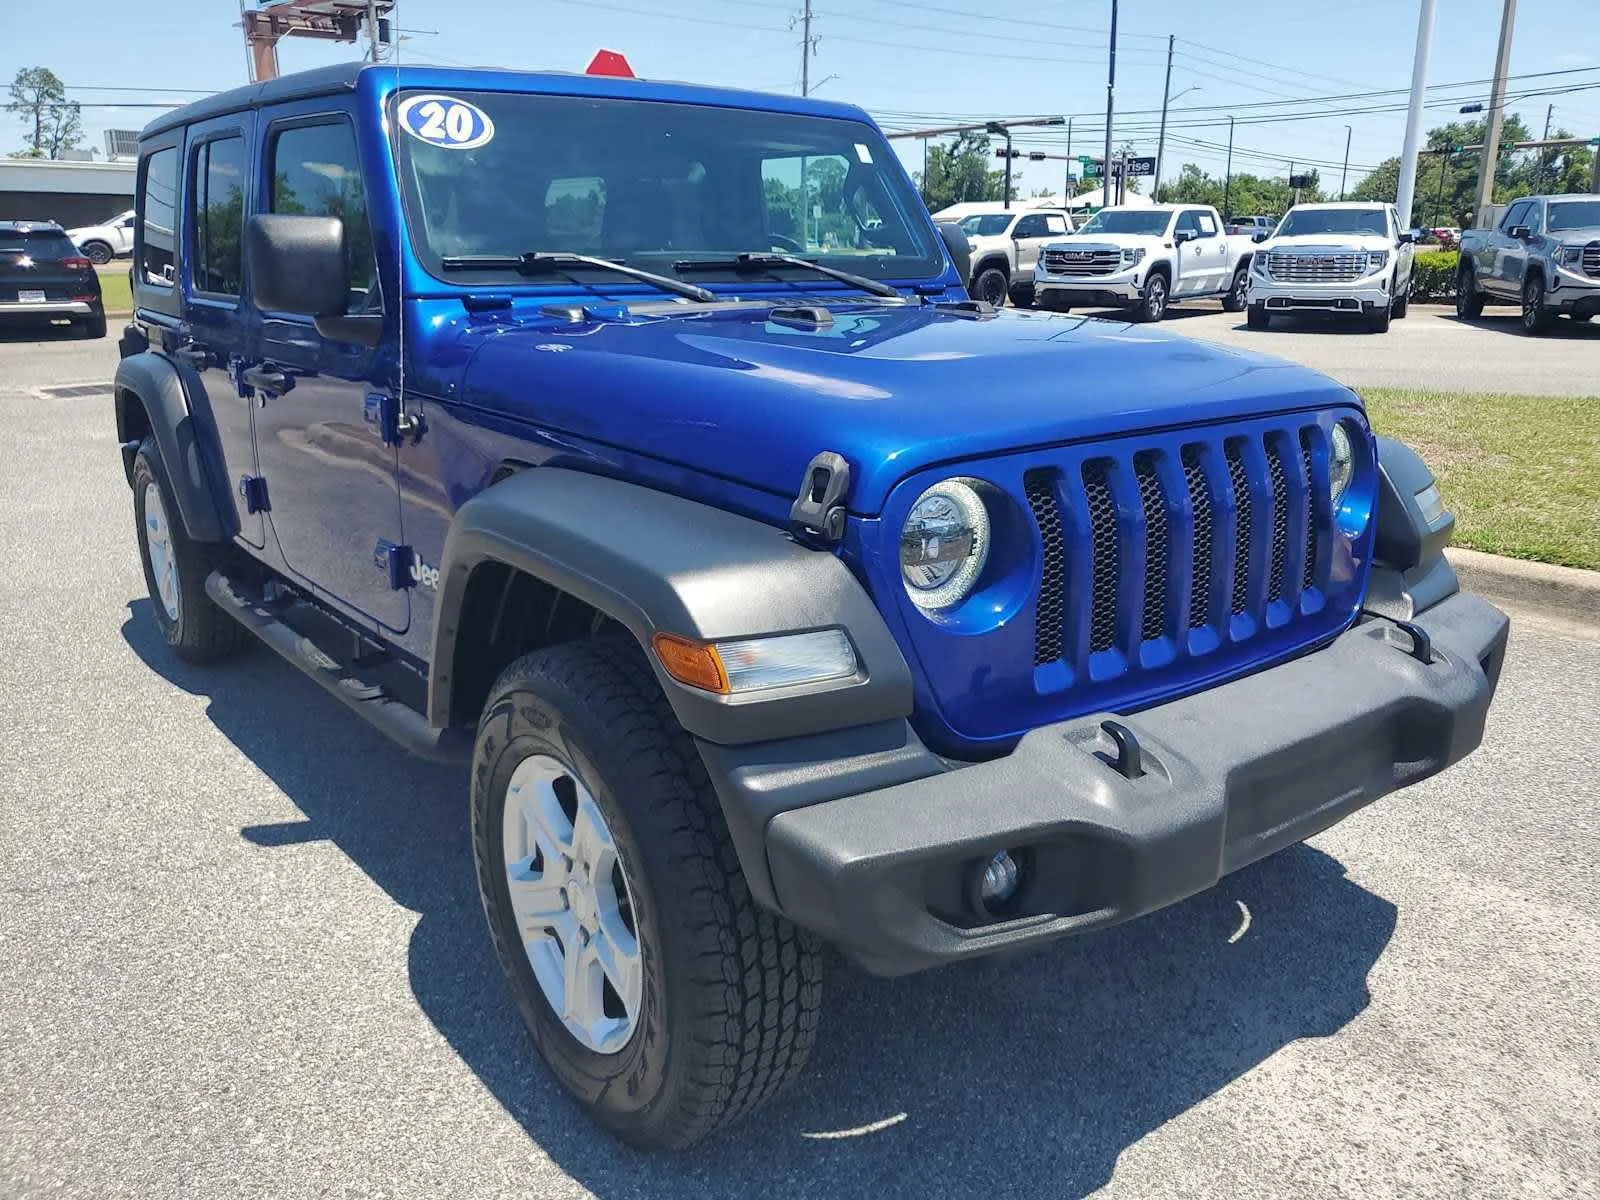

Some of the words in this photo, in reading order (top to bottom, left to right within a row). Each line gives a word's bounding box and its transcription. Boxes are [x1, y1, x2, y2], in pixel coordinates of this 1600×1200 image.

[419, 101, 474, 142] 20
[1086, 160, 1150, 174] enrrise
[1064, 252, 1093, 260] GMC
[410, 553, 440, 590] Jee
